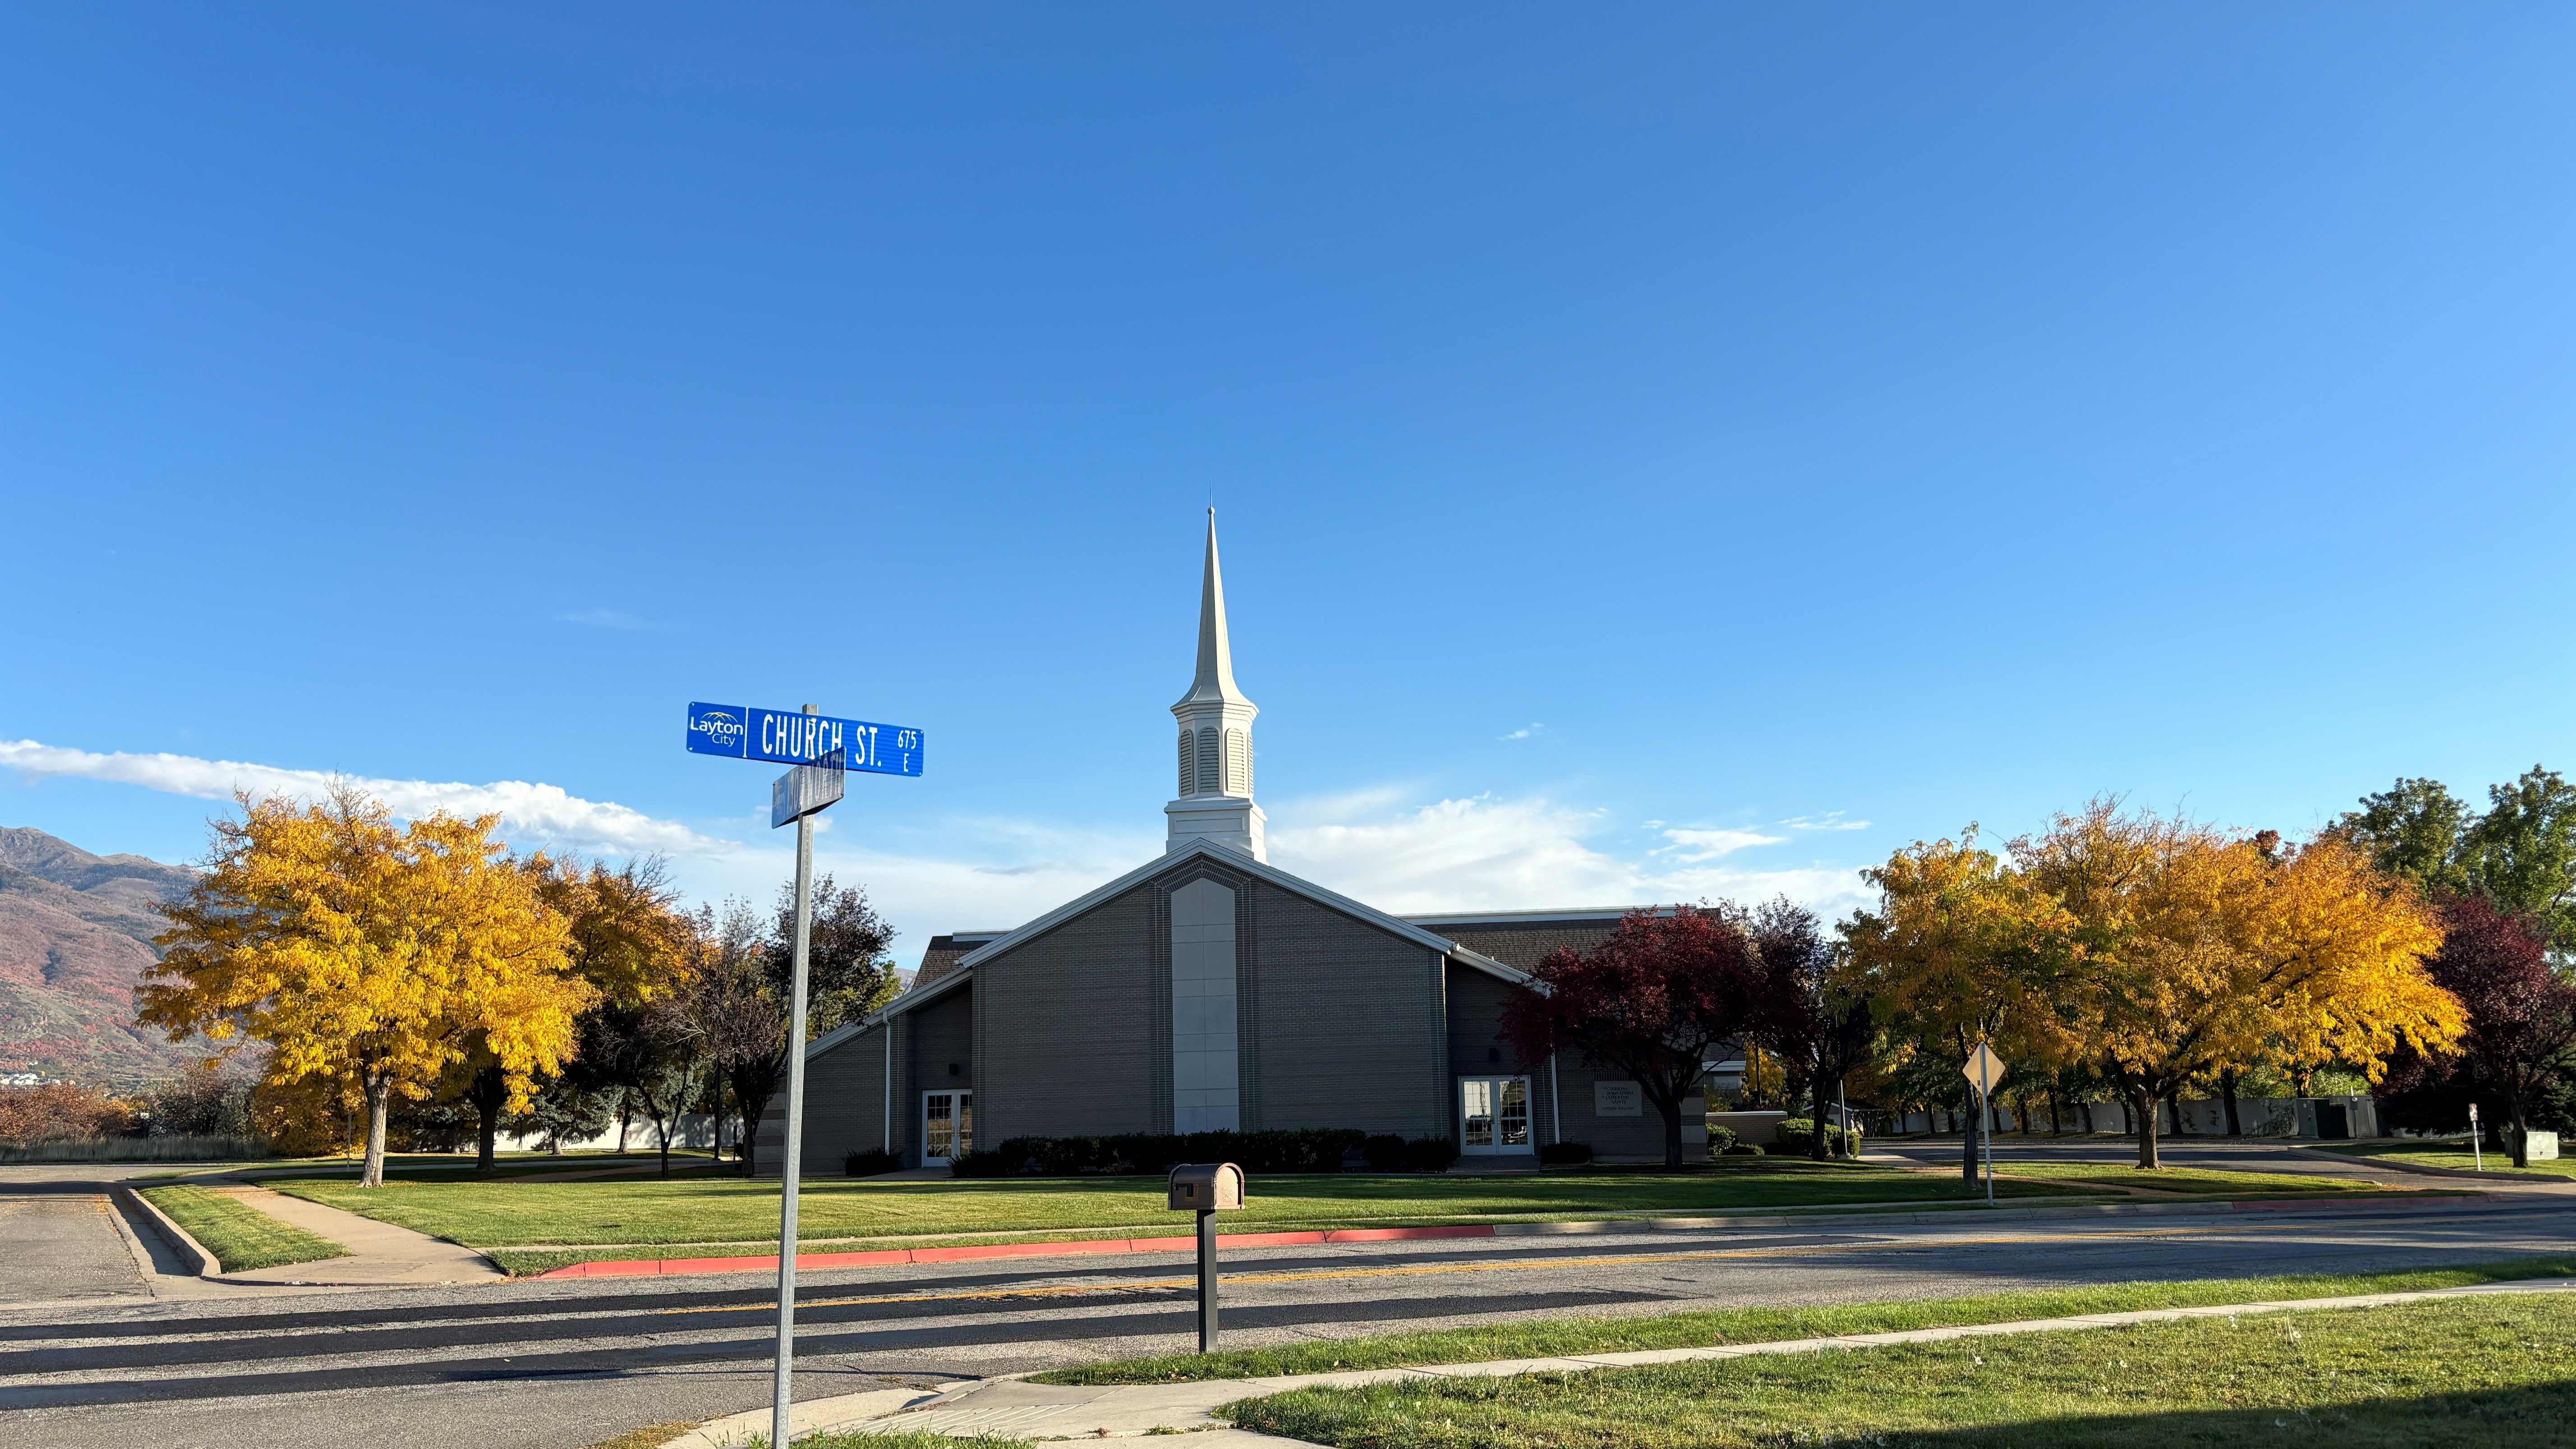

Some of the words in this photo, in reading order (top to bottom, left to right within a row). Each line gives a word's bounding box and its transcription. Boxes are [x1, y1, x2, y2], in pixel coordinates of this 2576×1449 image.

[690, 716, 743, 735] Layton
[712, 733, 736, 747] City
[762, 713, 843, 760] CHURCH
[855, 725, 882, 767] ST.
[898, 730, 916, 750] 675
[903, 753, 909, 773] E
